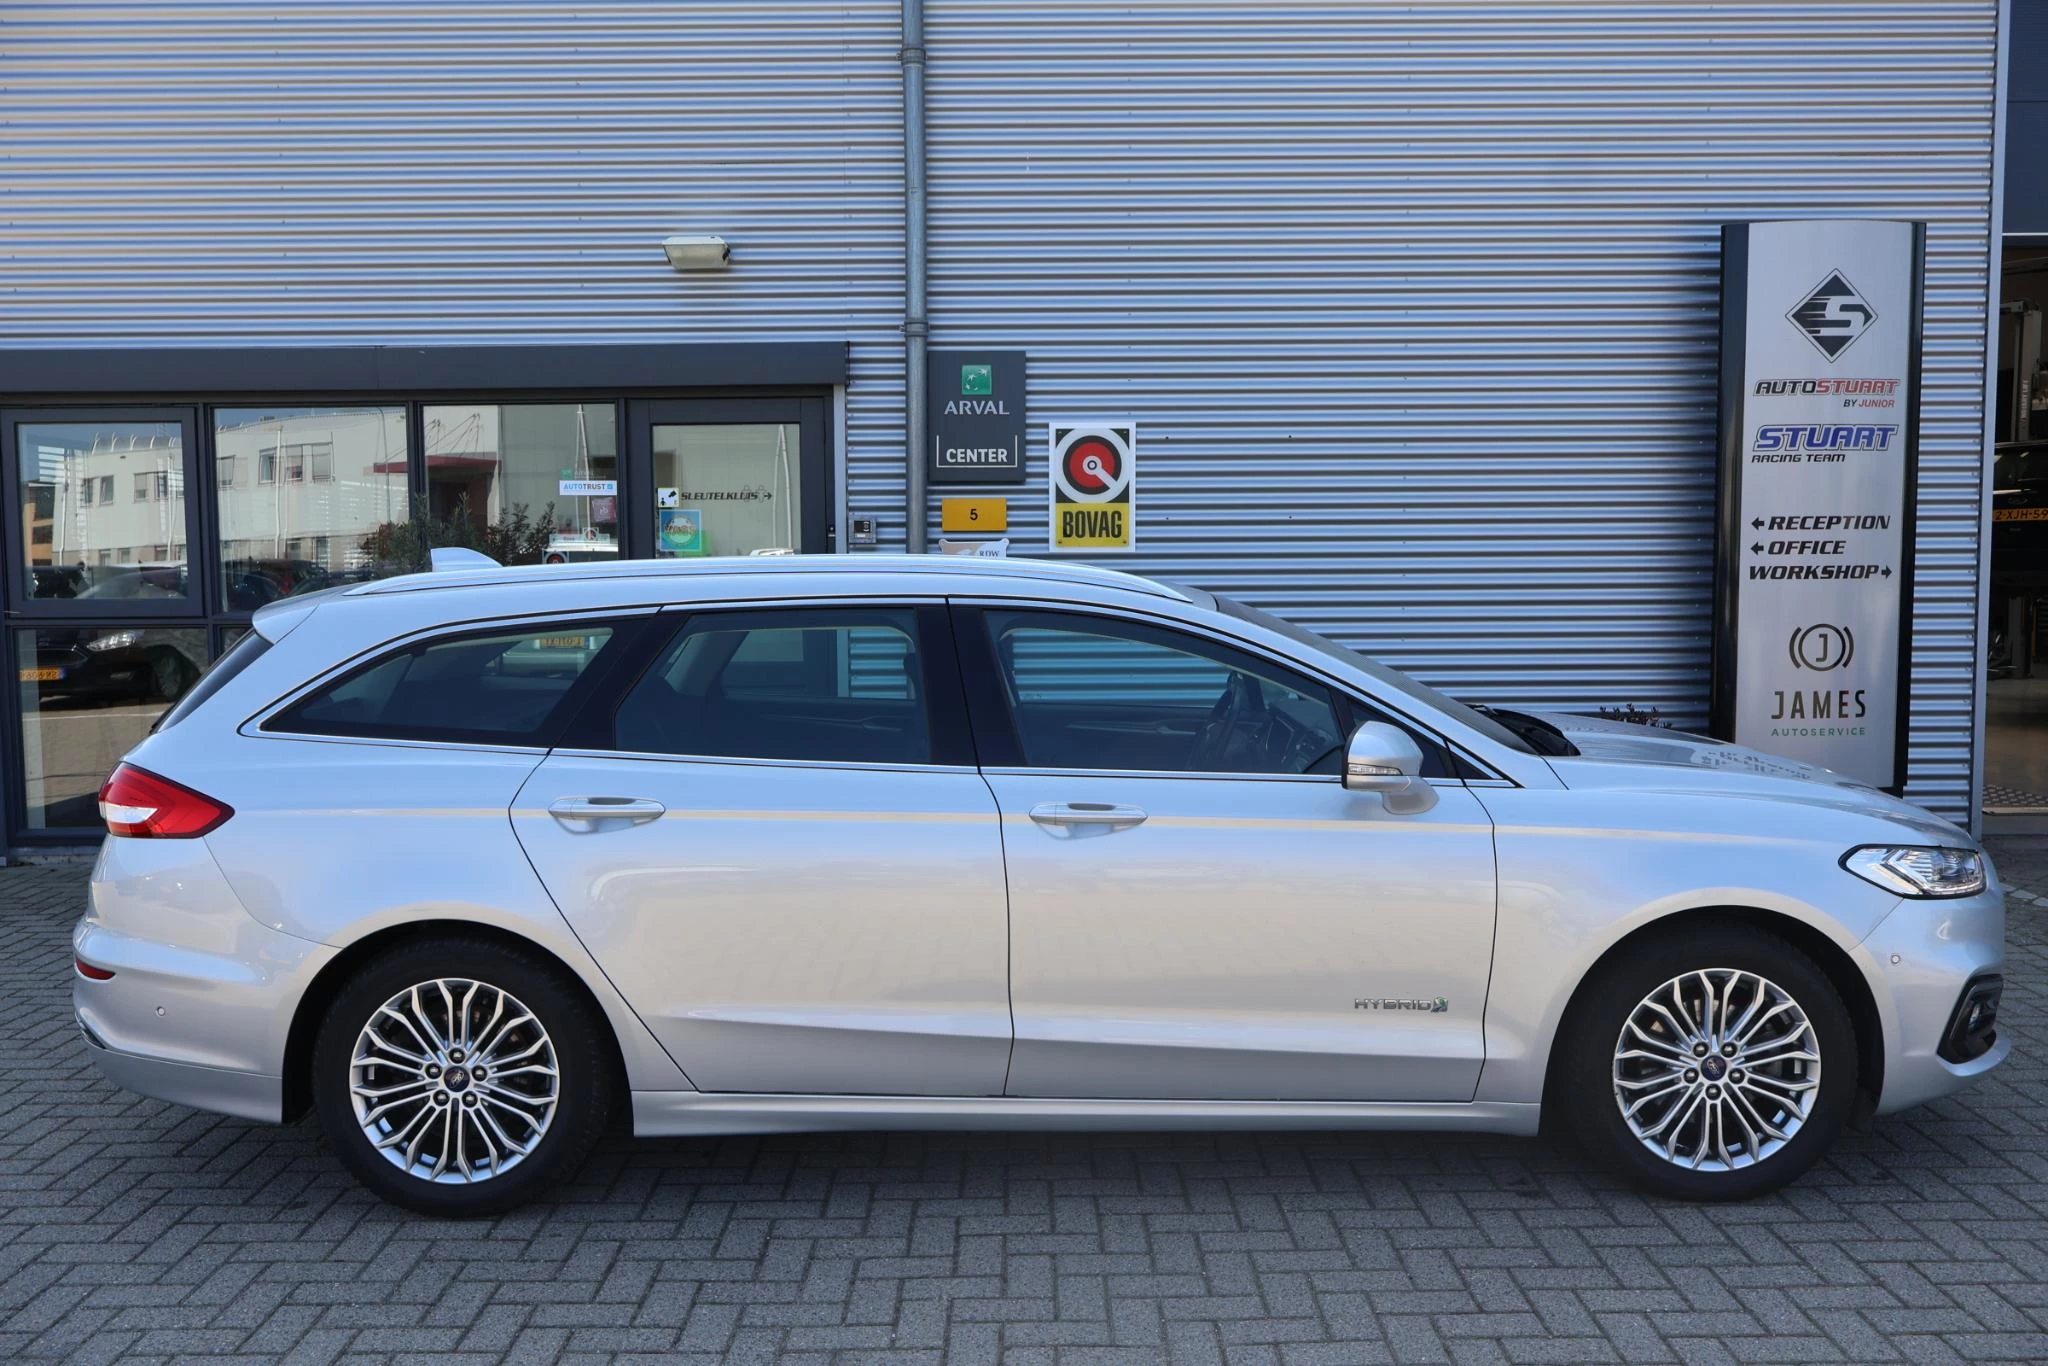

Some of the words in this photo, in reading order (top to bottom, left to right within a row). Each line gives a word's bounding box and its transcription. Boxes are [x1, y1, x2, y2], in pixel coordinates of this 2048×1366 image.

[1754, 379, 1899, 396] AUTOSTUART
[944, 400, 1009, 415] ARVAL
[1843, 399, 1857, 408] BY
[1858, 399, 1895, 408] JUNIOR
[1753, 424, 1899, 451] STUART
[946, 448, 1008, 463] CENTER
[1752, 454, 1801, 463] RACING
[1806, 453, 1845, 463] TEAM
[969, 508, 978, 521] 5
[1062, 510, 1122, 539] BOVAG
[1768, 515, 1890, 530] RECEPTION
[1768, 540, 1847, 555] OFFICE
[1749, 565, 1879, 580] WORKSHOP
[1771, 689, 1866, 719] JAMES
[1771, 727, 1866, 736] AUTOSERVICE
[1354, 998, 1431, 1011] HYBRID
